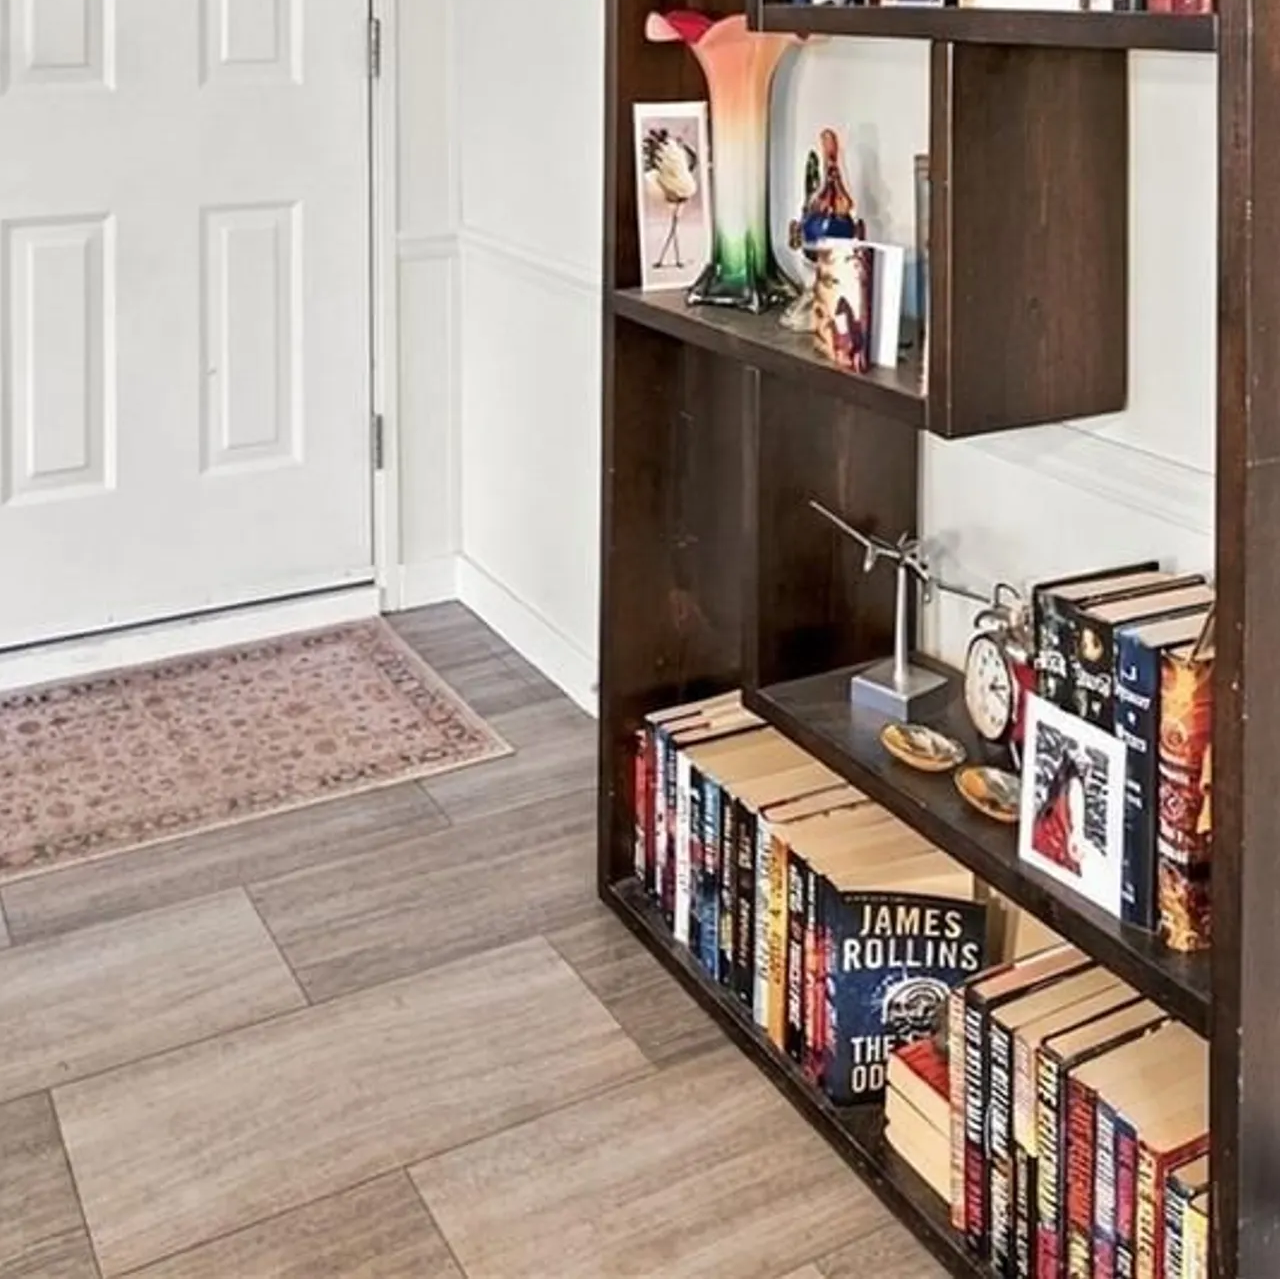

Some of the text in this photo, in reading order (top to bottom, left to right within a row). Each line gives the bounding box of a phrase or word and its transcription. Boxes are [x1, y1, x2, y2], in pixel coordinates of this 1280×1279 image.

[860, 905, 963, 938] JAMES
[843, 938, 979, 971] ROLLINS
[851, 1034, 895, 1063] THE
